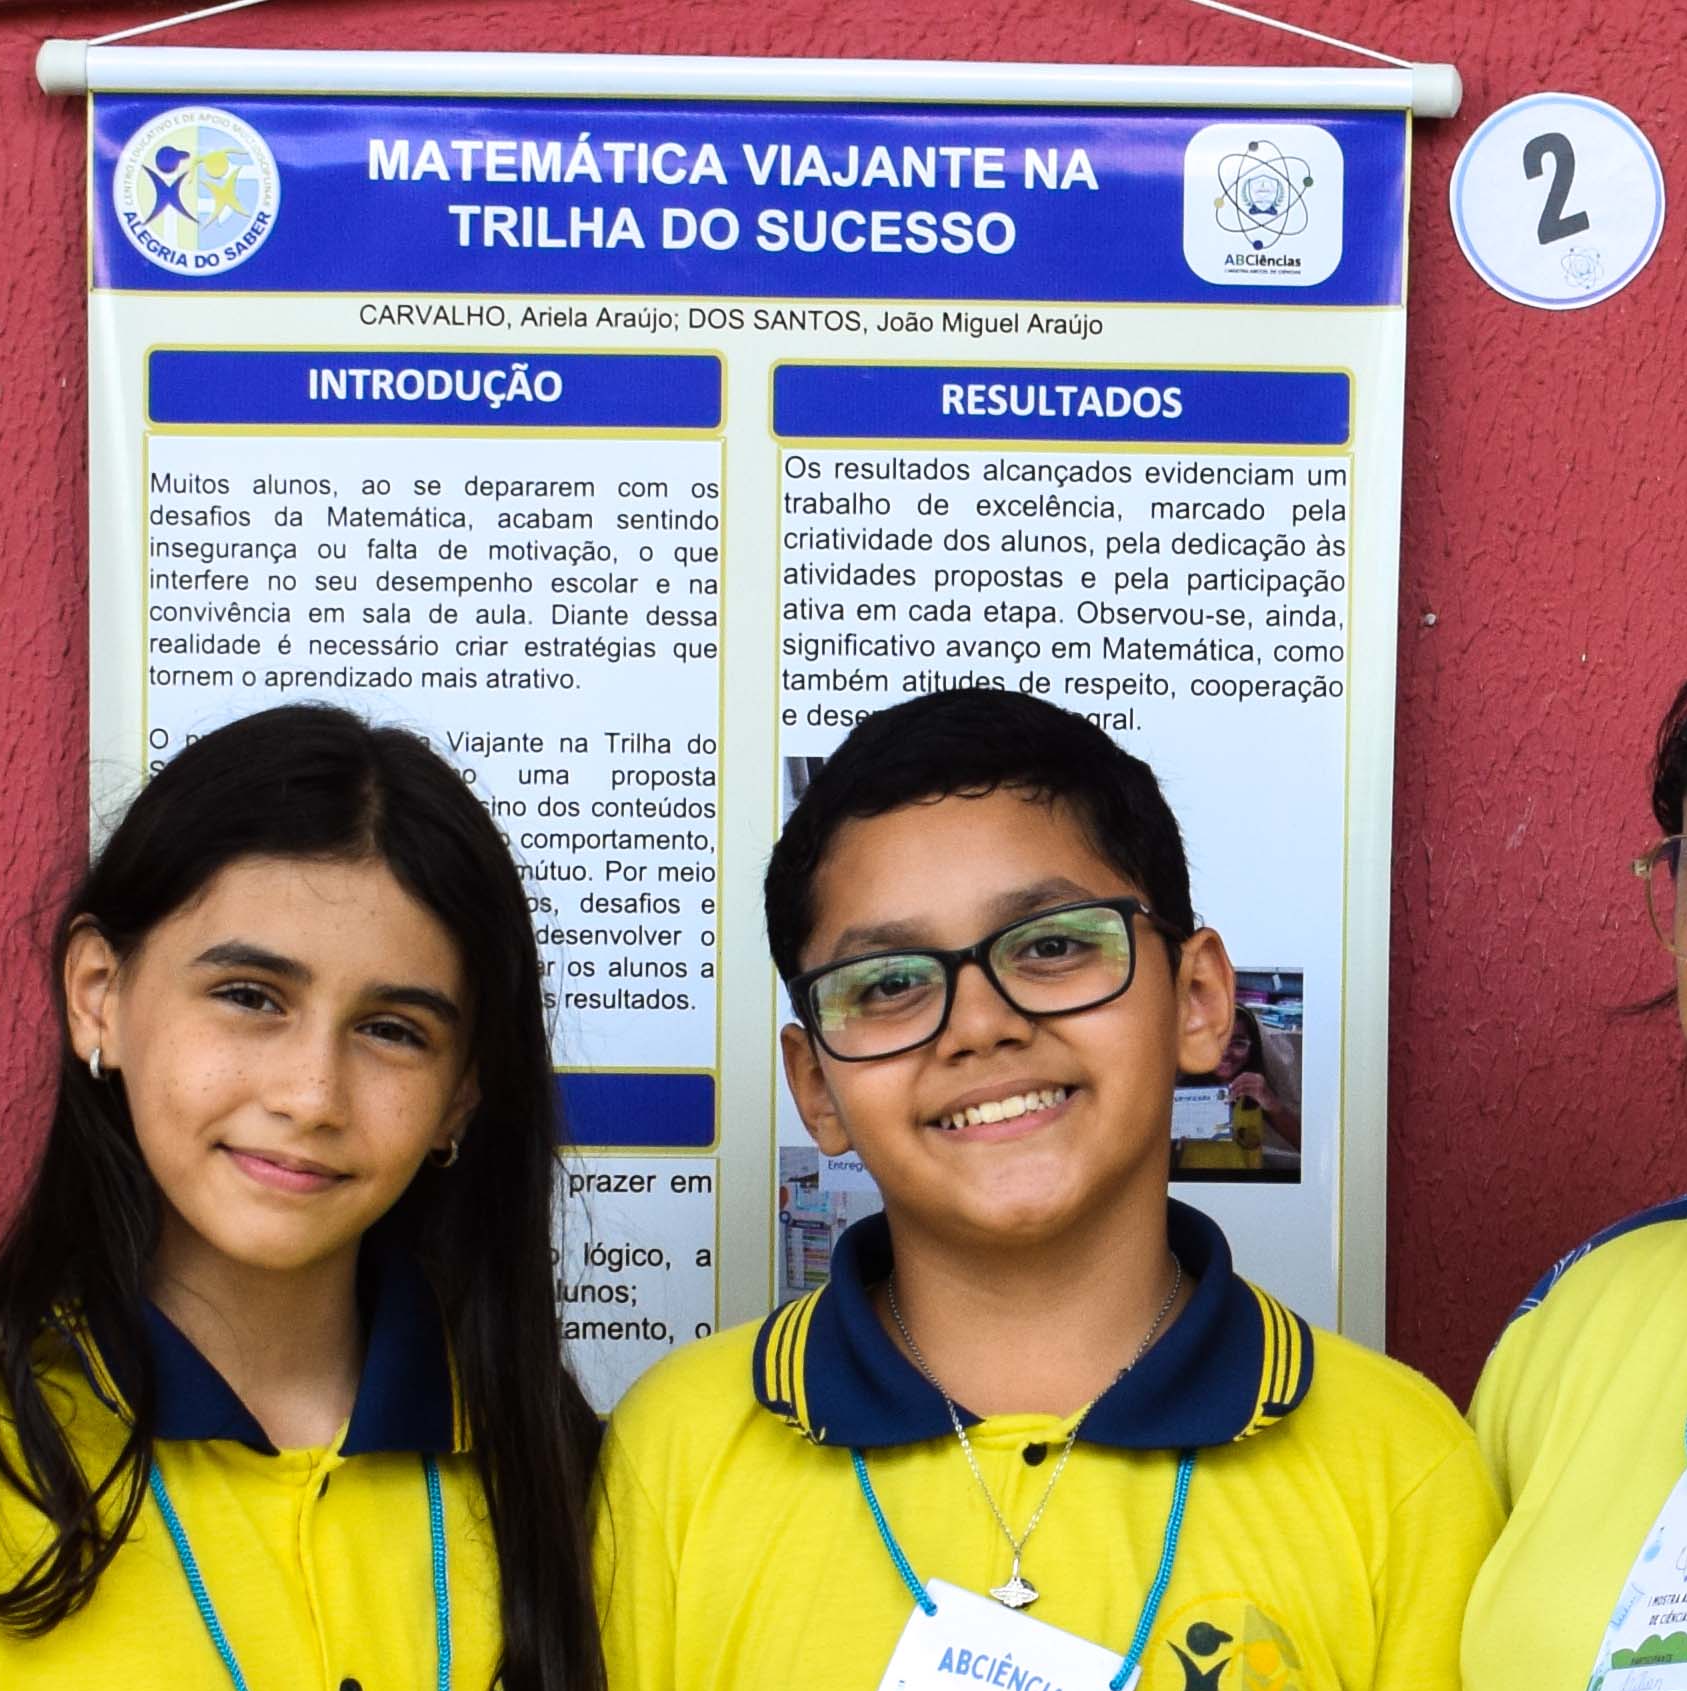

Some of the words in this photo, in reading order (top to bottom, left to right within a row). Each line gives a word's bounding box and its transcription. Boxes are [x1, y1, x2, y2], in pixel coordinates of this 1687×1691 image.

[367, 132, 728, 185] MATEMÁTICA
[742, 143, 1006, 189] VIAJANTE
[1023, 147, 1099, 191] NA
[1523, 132, 1590, 245] 2
[123, 211, 188, 267] ALEGRIA
[195, 253, 220, 268] DO
[224, 210, 271, 261] SABER
[447, 204, 646, 249] TRILHA
[662, 207, 740, 251] DO
[756, 208, 1016, 255] SUCESSO
[359, 303, 512, 330] CARVALHO,
[520, 306, 588, 328] Ariela
[595, 306, 679, 334] Araújo;
[688, 307, 745, 330] DOS
[753, 309, 868, 335] SANTOS,
[876, 311, 934, 333] João
[942, 311, 1019, 339] Miguel
[1026, 312, 1103, 341] Araújo
[309, 362, 563, 409] INTRODUÇÃO
[942, 383, 1183, 419] RESULTADOS
[150, 472, 230, 495] Muitos
[252, 473, 338, 498] alunos,
[361, 479, 391, 496] ao
[413, 479, 442, 496] se
[464, 475, 595, 502] depararem
[617, 481, 668, 498] com
[691, 482, 719, 500] os
[784, 455, 821, 479] Os
[834, 456, 970, 481] resultados
[983, 458, 1132, 489] alcançados
[1144, 460, 1294, 486] evidenciam
[1307, 468, 1347, 487] um
[149, 504, 251, 527] desafios
[274, 505, 303, 527] da
[327, 505, 473, 531] Matemática,
[497, 507, 593, 530] acabam
[616, 508, 719, 531] sentindo
[783, 491, 891, 516] trabalho
[917, 492, 949, 516] de
[976, 494, 1122, 523] excelência,
[1151, 497, 1265, 521] marcado
[1292, 498, 1346, 527] pela
[150, 536, 297, 565] insegurança
[317, 543, 347, 560] ou
[367, 537, 417, 560] falta
[438, 538, 468, 561] de
[488, 539, 618, 567] motivação,
[639, 545, 654, 562] o
[673, 546, 719, 568] que
[783, 526, 933, 552] criatividade
[943, 528, 991, 552] dos
[1000, 529, 1094, 557] alunos,
[1106, 531, 1161, 560] pela
[1171, 531, 1306, 562] dedicação
[1316, 533, 1346, 557] às
[150, 568, 249, 591] interfere
[268, 574, 297, 591] no
[315, 575, 357, 592] seu
[375, 570, 533, 598] desempenho
[551, 572, 639, 594] escolar
[655, 577, 671, 595] e
[689, 578, 718, 595] na
[783, 561, 916, 587] atividades
[934, 565, 1064, 593] propostas
[1080, 571, 1097, 589] e
[1114, 566, 1169, 595] pela
[1187, 567, 1345, 598] participação
[149, 601, 291, 623] convivência
[308, 607, 345, 624] em
[362, 602, 411, 624] sala
[428, 602, 458, 625] de
[475, 603, 533, 625] aula.
[551, 603, 629, 626] Diante
[645, 604, 718, 627] dessa
[783, 597, 845, 621] ativa
[856, 603, 896, 621] em
[908, 599, 971, 623] cada
[983, 600, 1064, 629] etapa.
[1076, 600, 1253, 630] Observou-se,
[1265, 603, 1343, 631] ainda,
[149, 633, 261, 655] realidade
[277, 633, 292, 656] é
[309, 634, 439, 657] necessário
[455, 635, 509, 657] criar
[524, 636, 656, 664] estratégias
[673, 642, 718, 664] que
[782, 632, 936, 662] significativo
[946, 639, 1041, 664] avanço
[1051, 641, 1091, 660] em
[1103, 636, 1262, 665] Matemática,
[1273, 644, 1344, 663] como
[149, 665, 233, 687] tornem
[241, 670, 257, 687] o
[264, 666, 413, 693] aprendizado
[421, 666, 478, 689] mais
[485, 667, 581, 690] atrativo.
[782, 667, 889, 692] também
[901, 670, 1006, 693] atitudes
[1018, 670, 1051, 694] de
[1064, 672, 1176, 701] respeito,
[1190, 675, 1344, 704] cooperação
[446, 730, 544, 758] Viajante
[559, 736, 588, 754] na
[603, 732, 671, 755] Trilha
[687, 733, 717, 755] do
[518, 768, 569, 786] uma
[611, 766, 716, 792] proposta
[537, 795, 581, 818] dos
[591, 796, 716, 819] conteúdos
[519, 829, 715, 857] comportamento,
[605, 860, 648, 882] Por
[658, 861, 716, 883] meio
[580, 892, 681, 914] desafios
[536, 924, 682, 947] desenvolver
[567, 961, 595, 978] os
[608, 956, 688, 978] alunos
[565, 988, 695, 1010] resultados.
[828, 1160, 862, 1172] Entreg
[569, 1174, 657, 1198] prazer
[670, 1175, 712, 1194] em
[584, 1242, 671, 1273] lógico,
